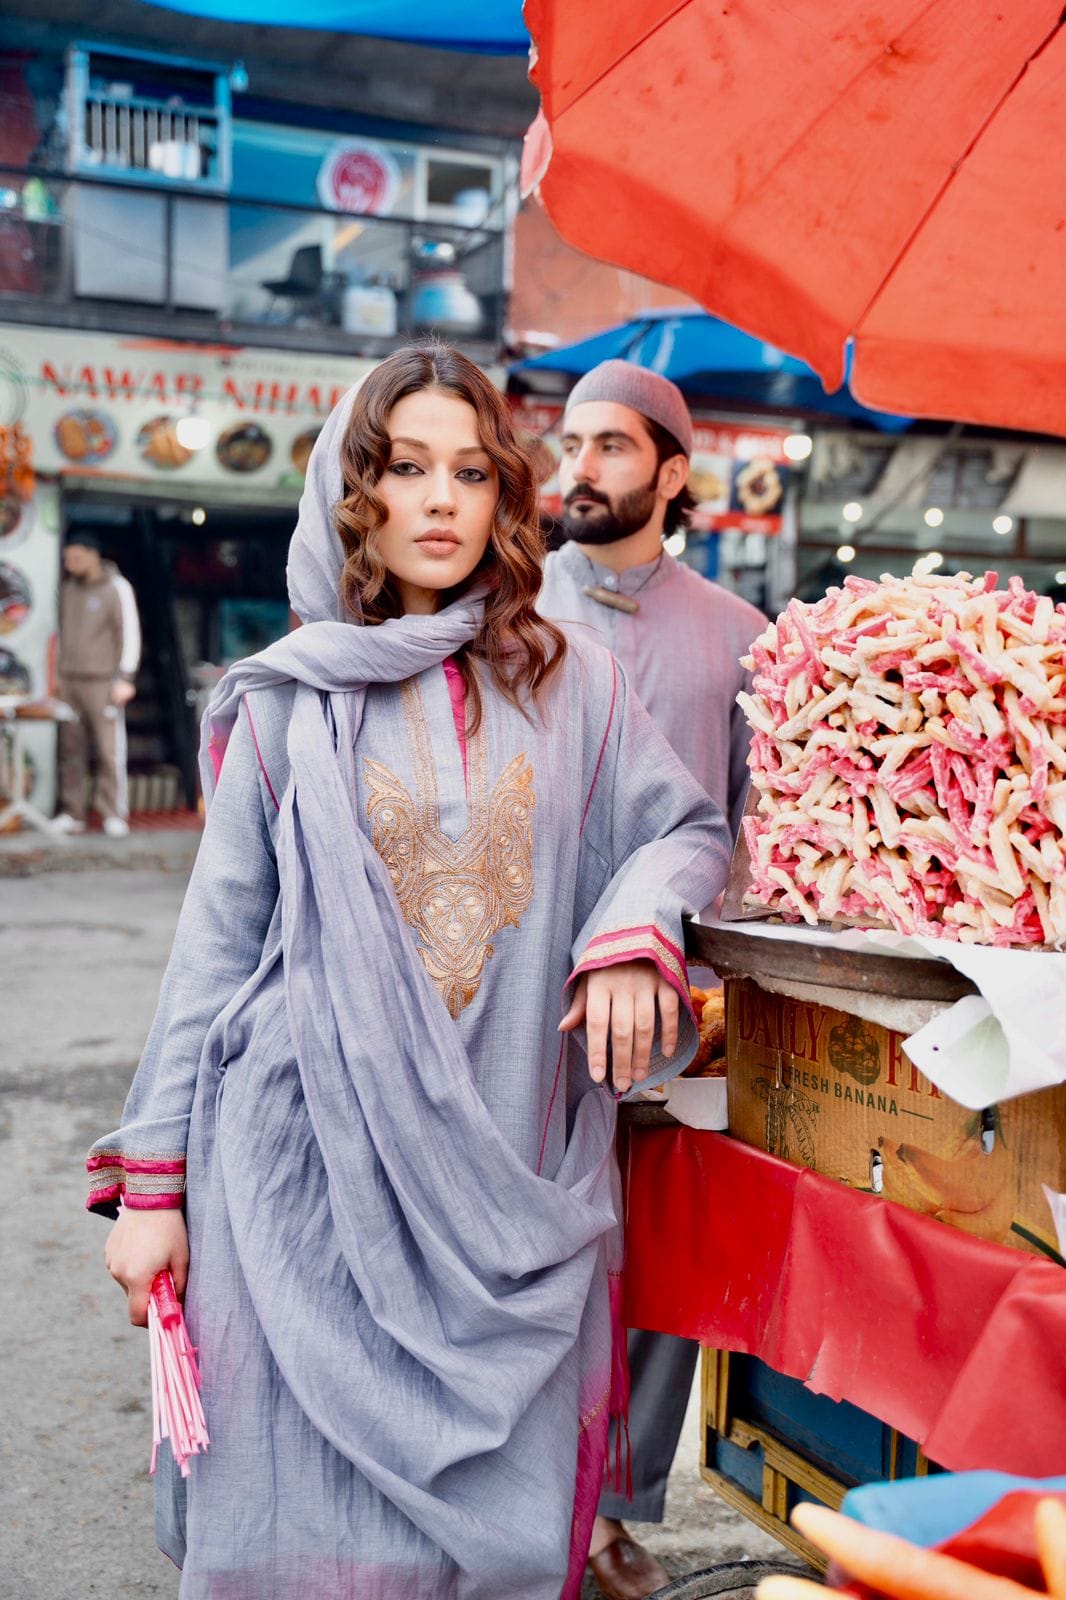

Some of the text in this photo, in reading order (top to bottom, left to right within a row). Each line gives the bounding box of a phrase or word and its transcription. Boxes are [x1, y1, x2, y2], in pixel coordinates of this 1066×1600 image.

[738, 990, 827, 1063] DAILY
[787, 1066, 898, 1116] FRESH BANANA
